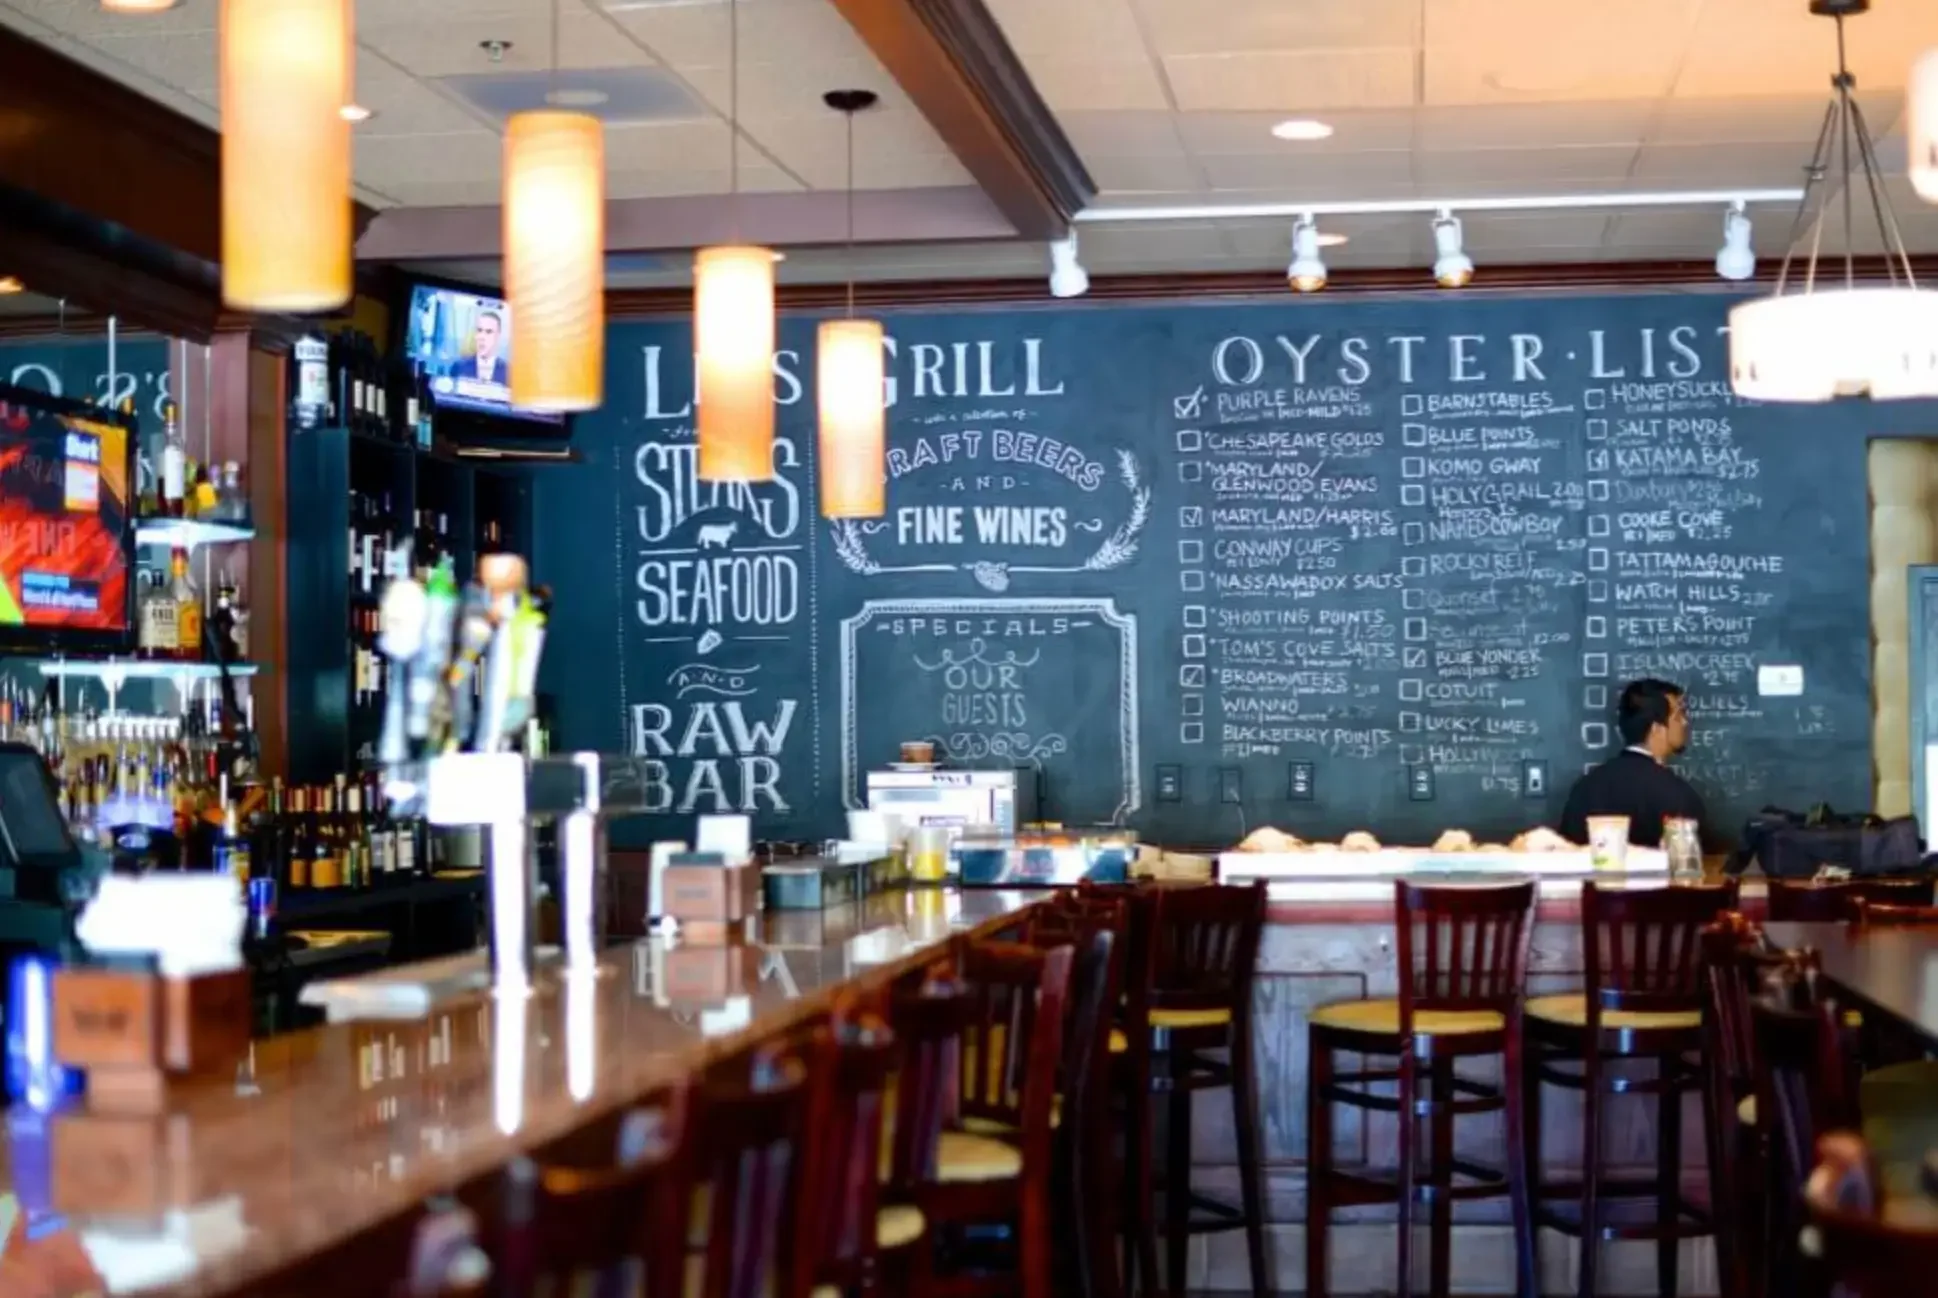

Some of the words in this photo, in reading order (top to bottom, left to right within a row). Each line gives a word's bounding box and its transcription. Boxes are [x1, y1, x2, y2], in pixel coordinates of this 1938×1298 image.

[1212, 334, 1546, 386] OYSTER
[1589, 327, 1732, 378] LIS
[1217, 389, 1288, 412] PURPLE
[1294, 386, 1362, 404] RAVENS
[1427, 391, 1553, 412] BARNSTABLES
[1611, 380, 1734, 402] HONEYSUCKL
[1428, 427, 1477, 445] BLUE
[1615, 418, 1663, 438] SALT
[1667, 416, 1733, 435] PONDS
[1207, 432, 1327, 449] CHESAPEAKE
[1330, 431, 1385, 447] GOLDS
[880, 430, 982, 484] RAFT
[993, 430, 1105, 491] BEERS
[1427, 457, 1484, 476] KOMO
[1489, 457, 1542, 475] GWAY
[1615, 447, 1698, 468] KATAMA
[1702, 447, 1743, 465] BAY
[1211, 476, 1314, 492] GLENWOOD
[1320, 476, 1379, 493] EVANS
[898, 506, 963, 546] FINE
[974, 506, 1068, 547] WINES
[1215, 538, 1292, 559] CONWAY
[1294, 537, 1343, 555] CUPS
[1612, 552, 1783, 573] TATTAMAGOUCHE
[637, 555, 798, 625] SEAFOOD
[1353, 572, 1404, 589] SALTS
[1615, 583, 1678, 601] WATCH
[1688, 583, 1740, 600] HILLS
[891, 618, 1069, 636] SPECIALS
[1217, 609, 1309, 626] SHOOTING
[1319, 609, 1386, 625] POINTS
[1617, 617, 1698, 637] PETERS
[1703, 615, 1756, 631] POINT
[1219, 638, 1275, 656] TOM'S
[1283, 640, 1335, 656] COVE
[1340, 640, 1396, 657] SALTS
[944, 664, 1021, 690] OUR
[1219, 668, 1348, 686] BROADWATERS
[942, 692, 1027, 727] GUESTS
[1220, 698, 1300, 715] WIANNO
[630, 700, 798, 757] RAW
[1425, 715, 1480, 731] LUCKY
[1222, 724, 1330, 744] BLACKBERRY
[1334, 728, 1393, 747] POINTS
[630, 756, 792, 813] BAR
